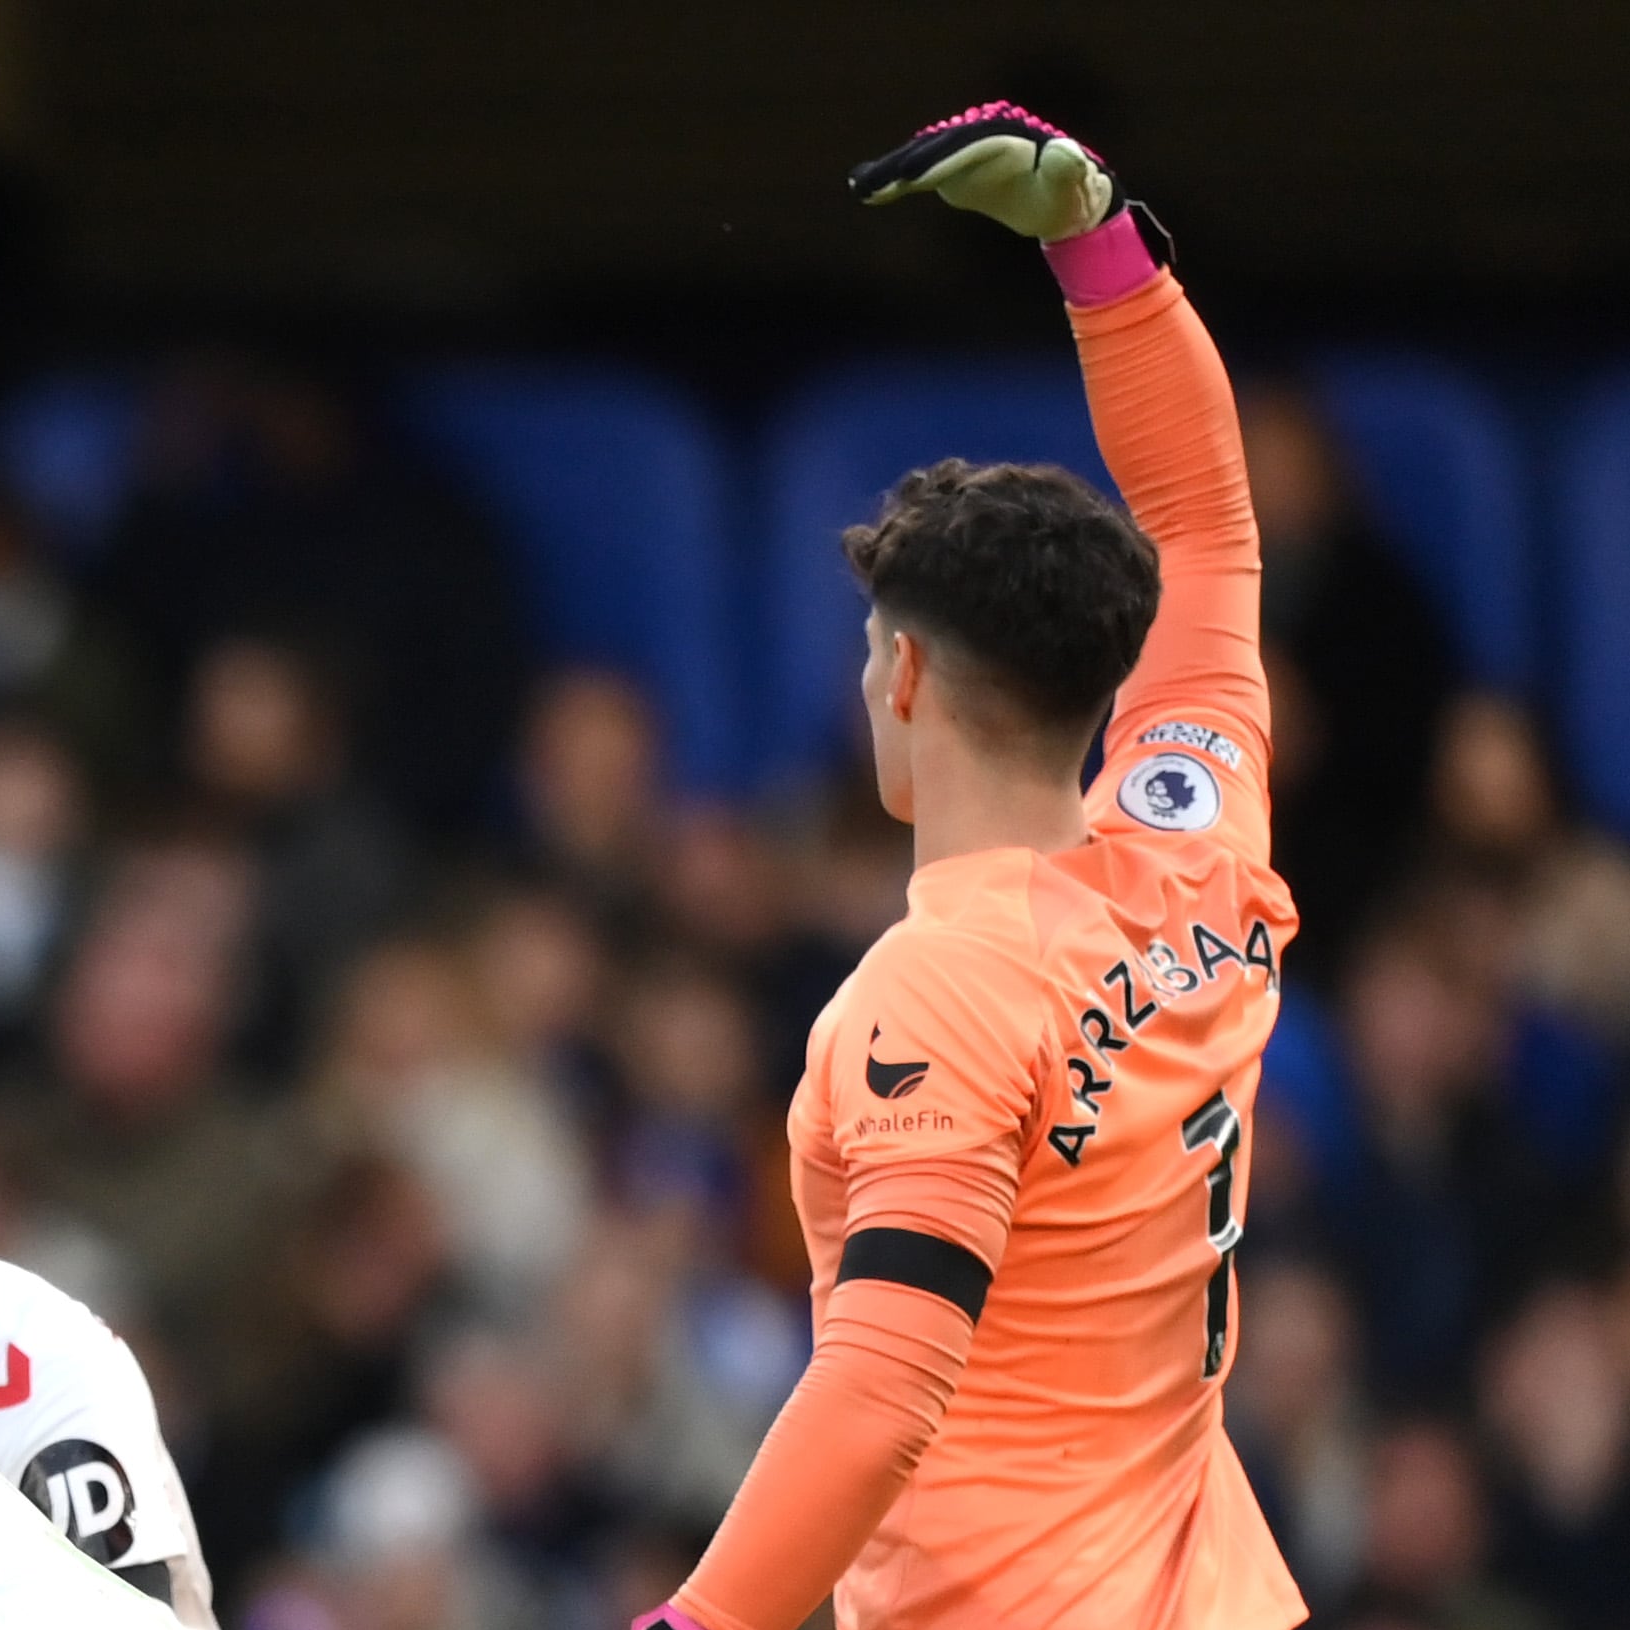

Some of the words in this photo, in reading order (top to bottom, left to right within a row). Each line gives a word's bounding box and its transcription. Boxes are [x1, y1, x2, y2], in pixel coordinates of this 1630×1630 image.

[853, 1109, 954, 1138] WhaleFin
[1180, 1087, 1243, 1382] 1
[45, 1460, 126, 1539] JD
